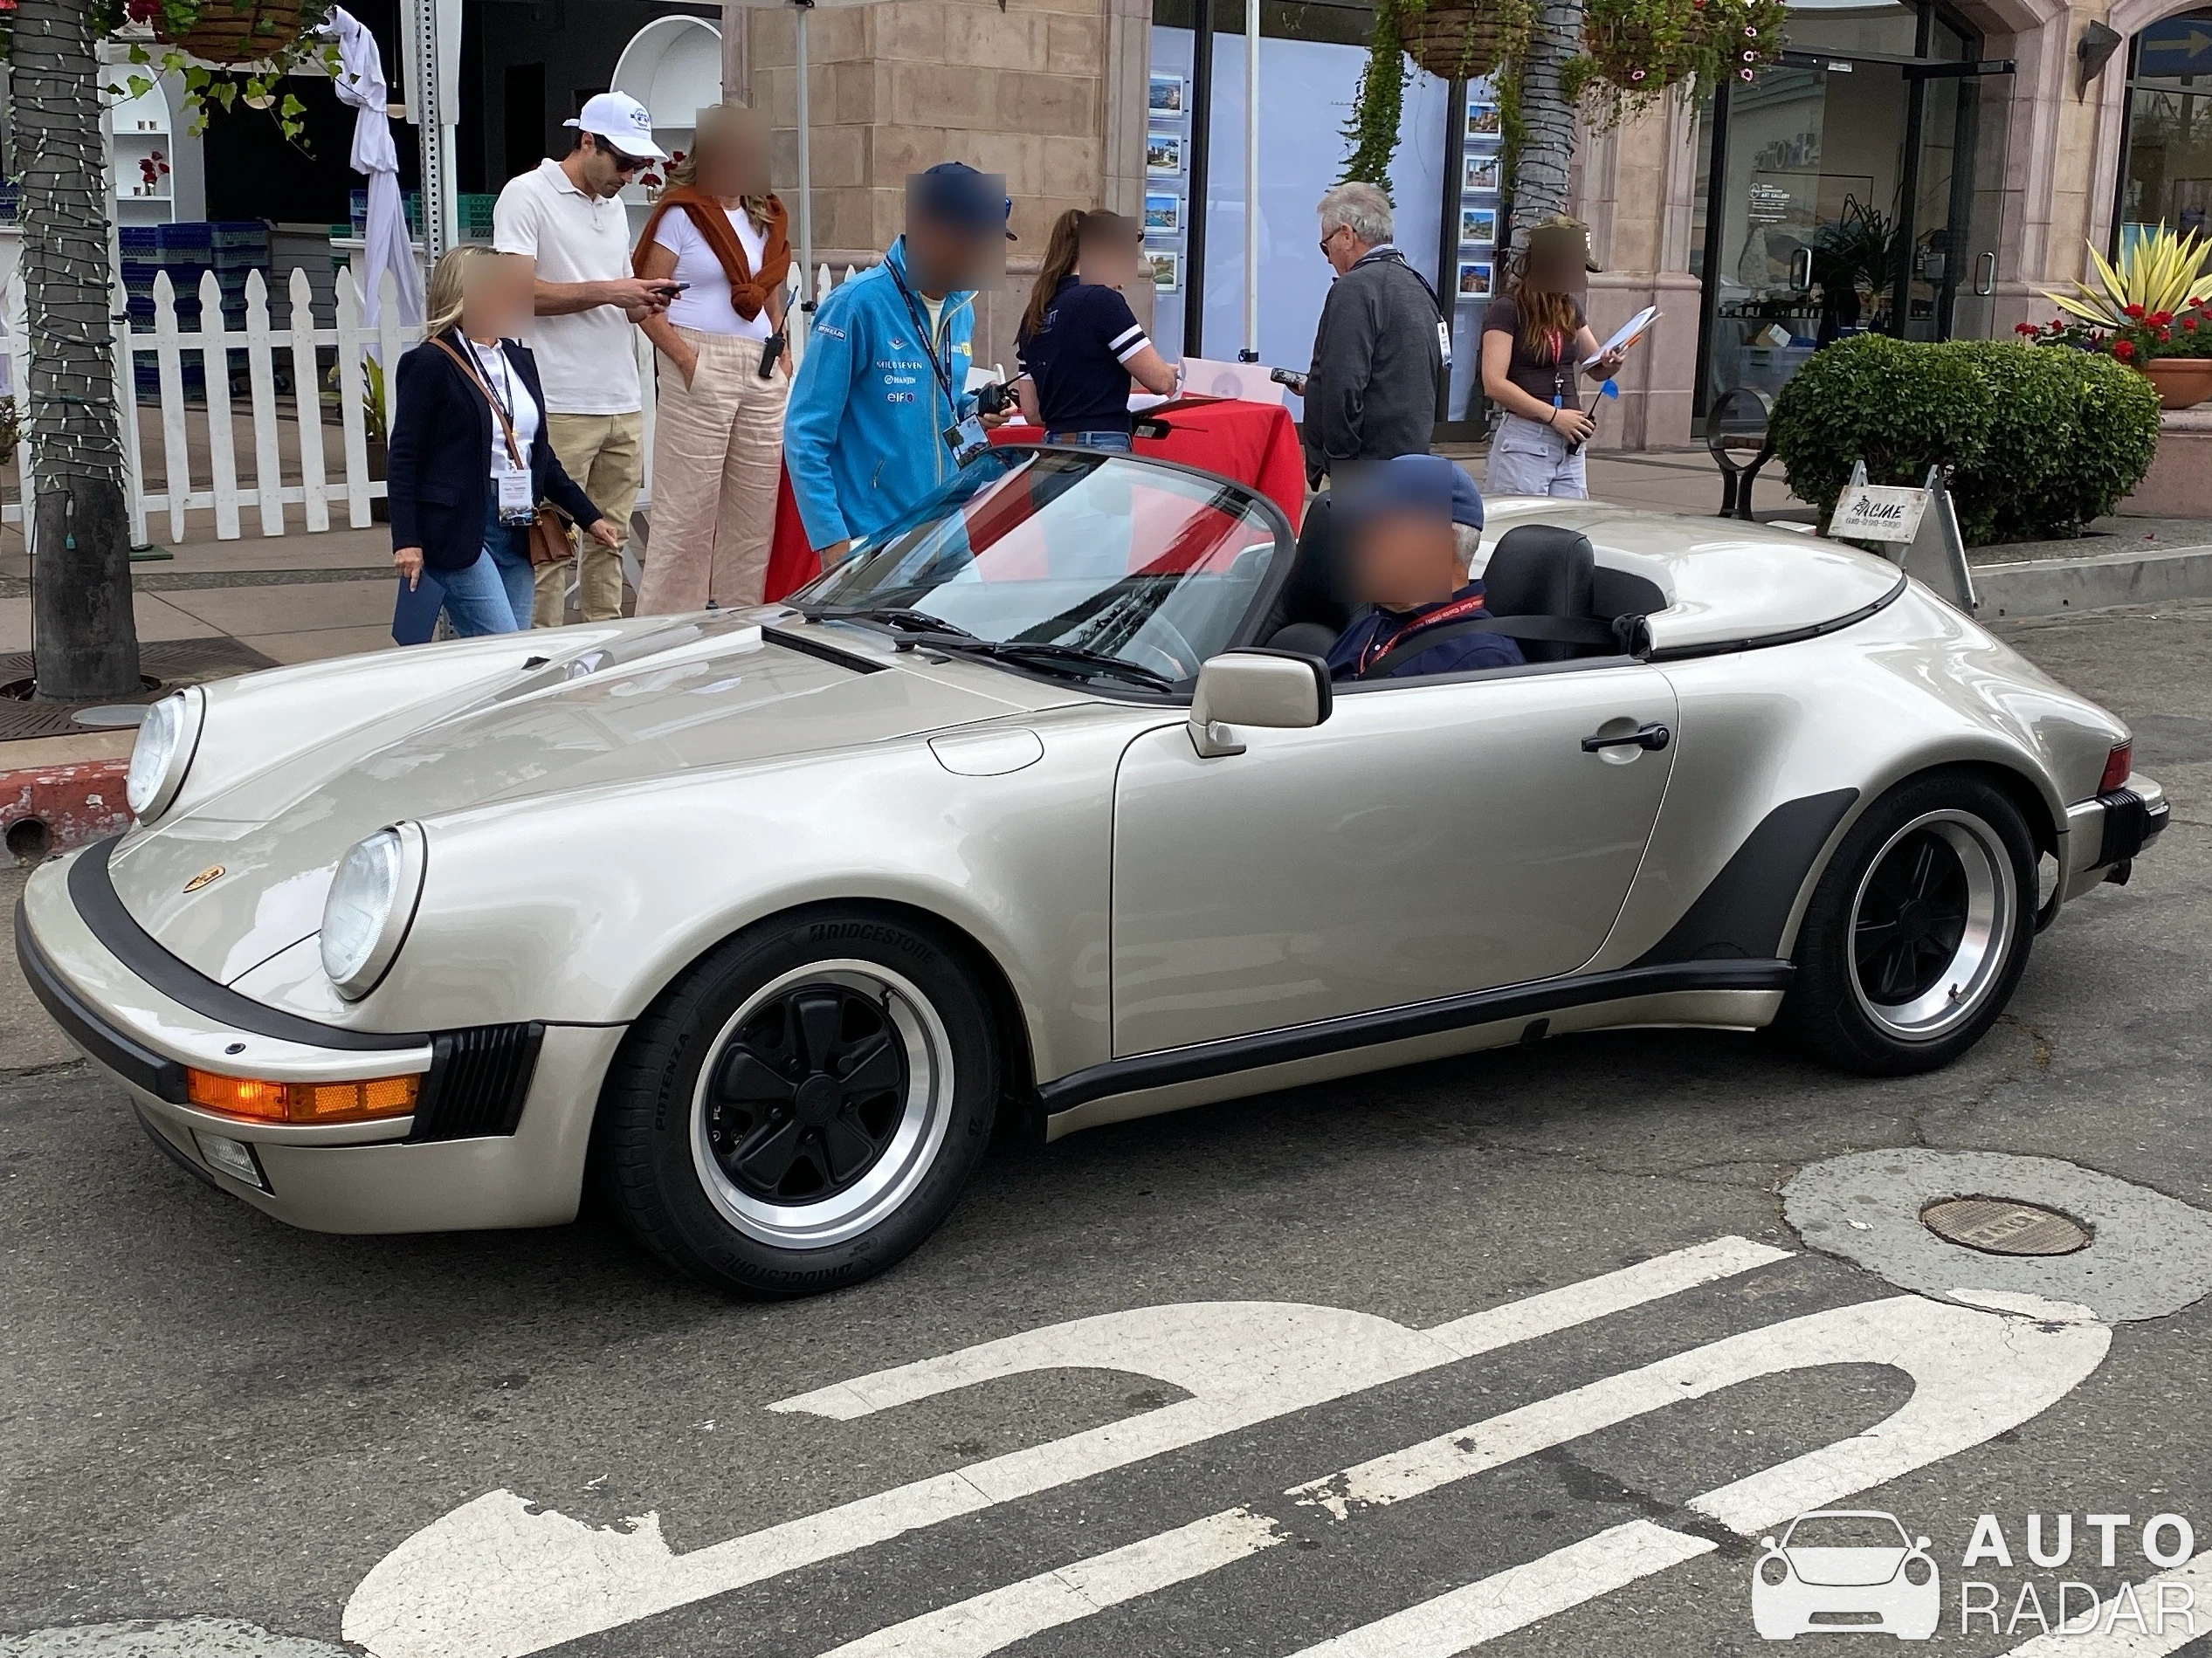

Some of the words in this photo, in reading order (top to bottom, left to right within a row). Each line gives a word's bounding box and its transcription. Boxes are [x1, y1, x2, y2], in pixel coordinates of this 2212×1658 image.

[898, 361, 922, 369] SEVEN
[893, 376, 916, 385] HANJIN
[887, 392, 905, 402] elf
[1855, 502, 1905, 519] ACME
[809, 923, 938, 963] BRIDGESTONE
[654, 1033, 692, 1132] POTENZA
